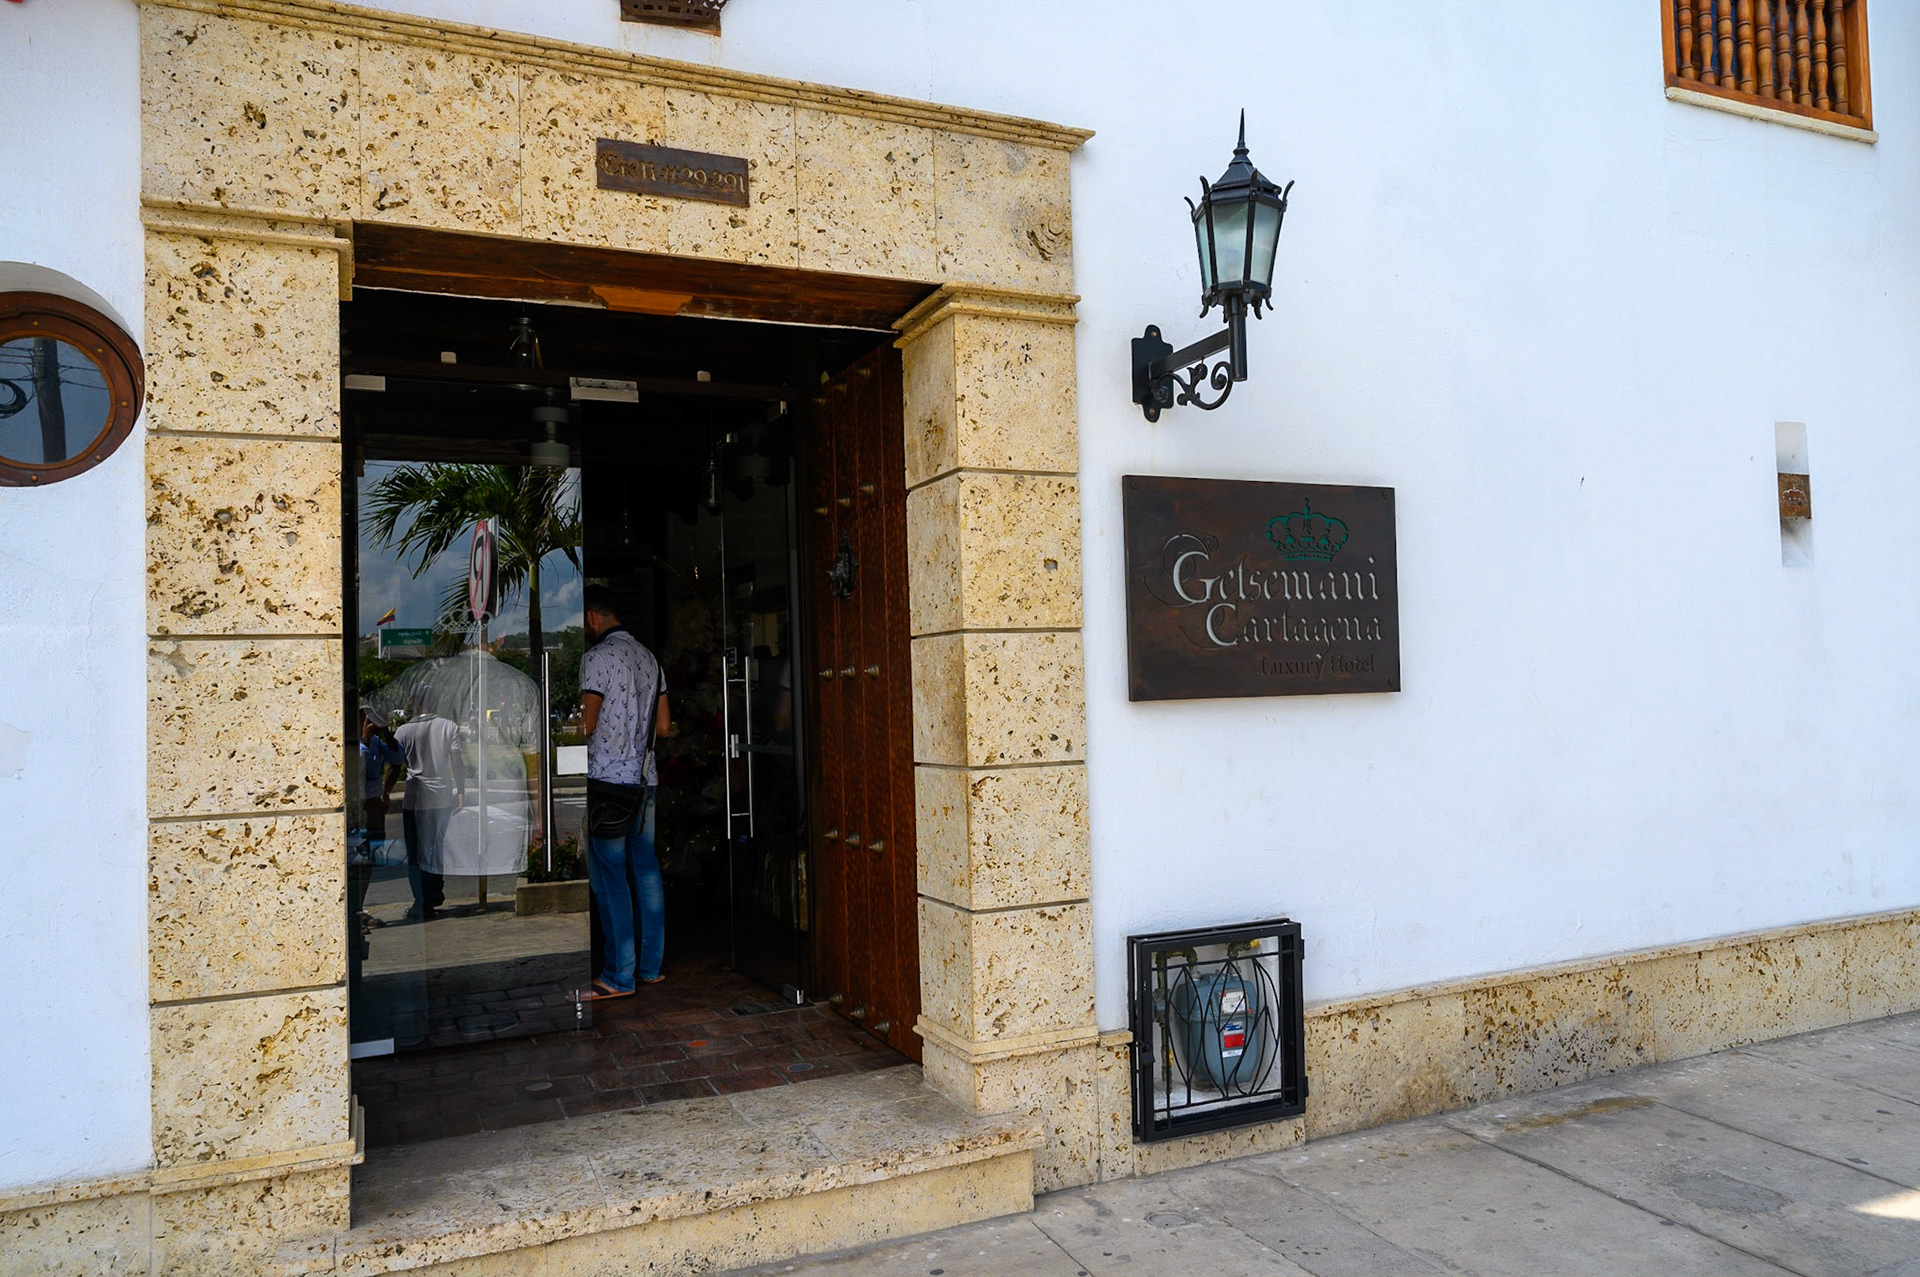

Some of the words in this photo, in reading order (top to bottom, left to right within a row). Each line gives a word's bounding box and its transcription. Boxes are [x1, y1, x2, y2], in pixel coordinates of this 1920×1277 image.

[1162, 534, 1384, 607] Getsemani
[1193, 602, 1384, 657] Cartagena
[1260, 656, 1323, 679] Luxury
[1331, 655, 1375, 674] Hotel
